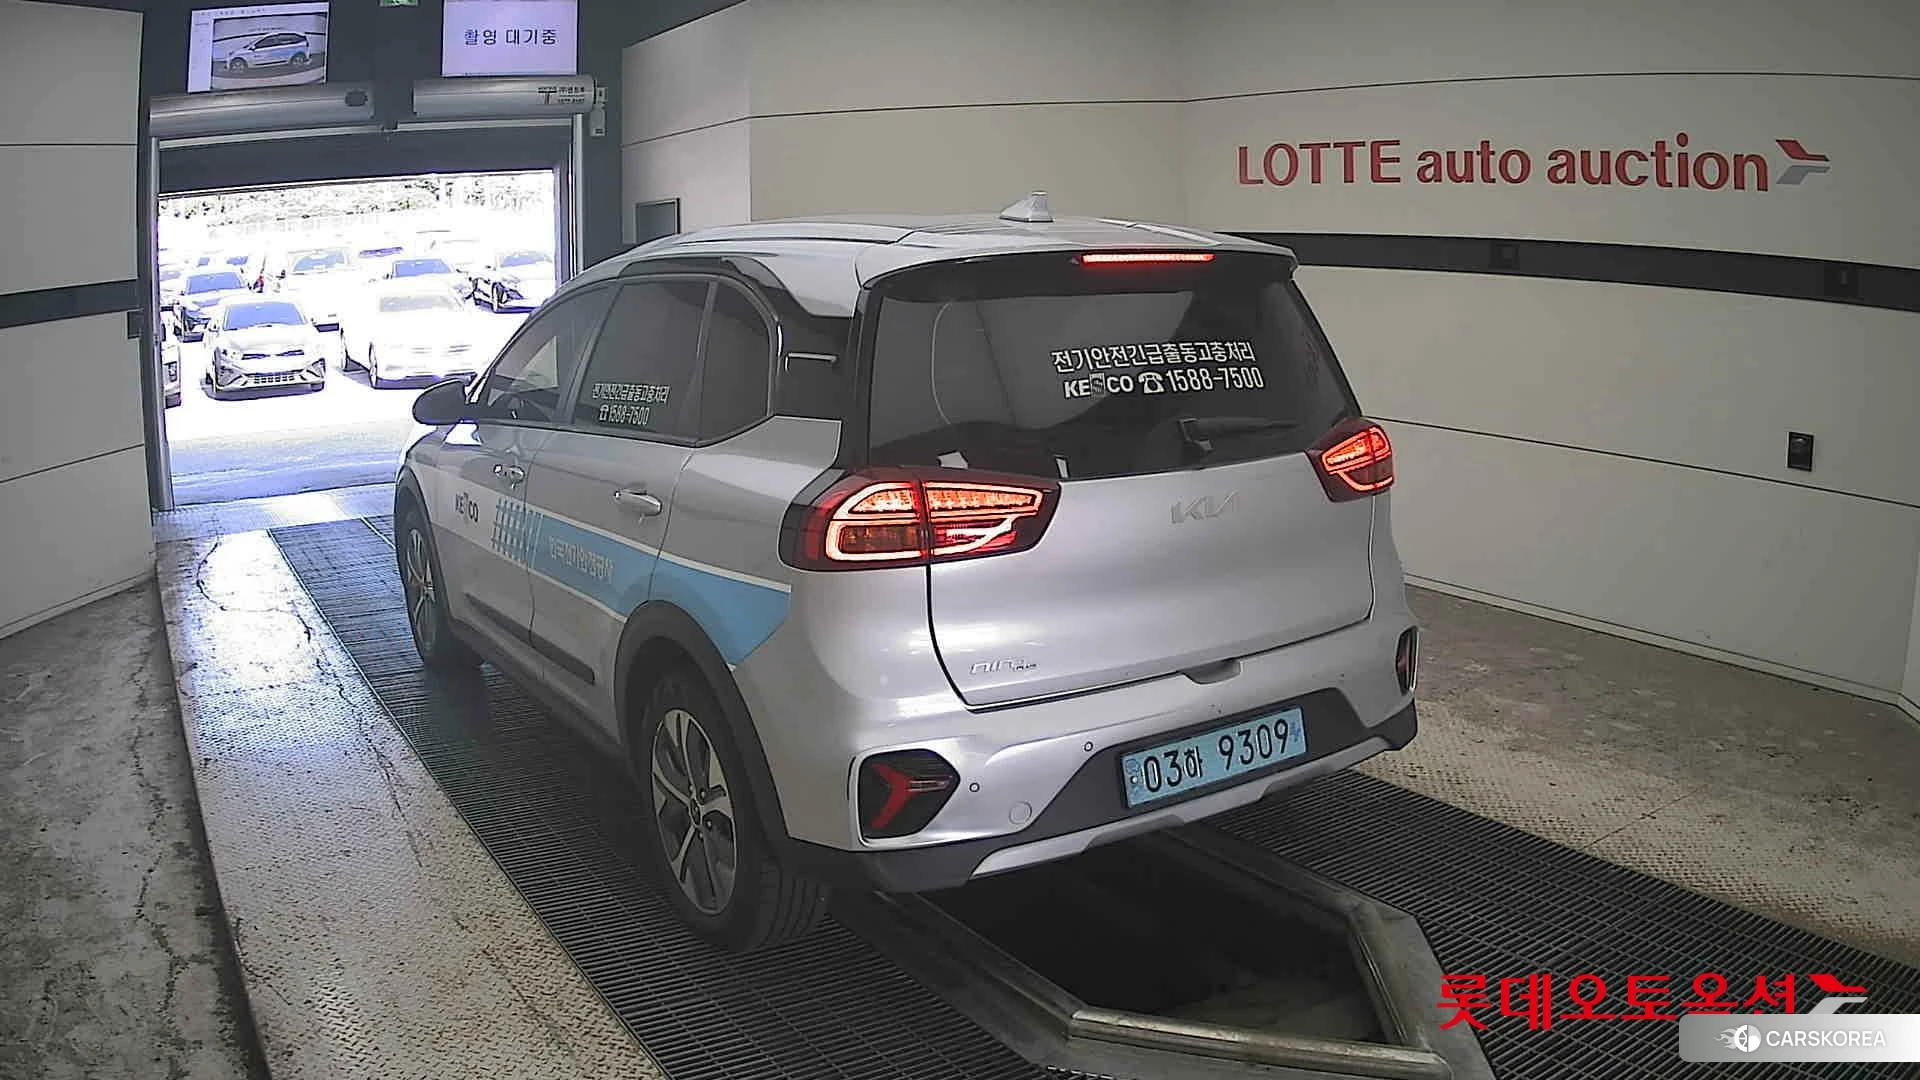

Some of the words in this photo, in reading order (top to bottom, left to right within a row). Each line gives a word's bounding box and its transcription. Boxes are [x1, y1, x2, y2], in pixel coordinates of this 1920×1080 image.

[464, 28, 498, 46] 촬영
[505, 28, 557, 46] 대기중
[1238, 139, 1401, 186] LOTTE
[1416, 139, 1531, 185] auto
[1546, 132, 1769, 192] auction
[1051, 341, 1256, 374] 전기안전긴급출동고충처리
[1165, 366, 1265, 393] 1588-7500
[455, 491, 480, 523] KECO
[1170, 489, 1241, 525] KIA
[1143, 746, 1204, 793] 03하
[1218, 718, 1290, 771] 9309
